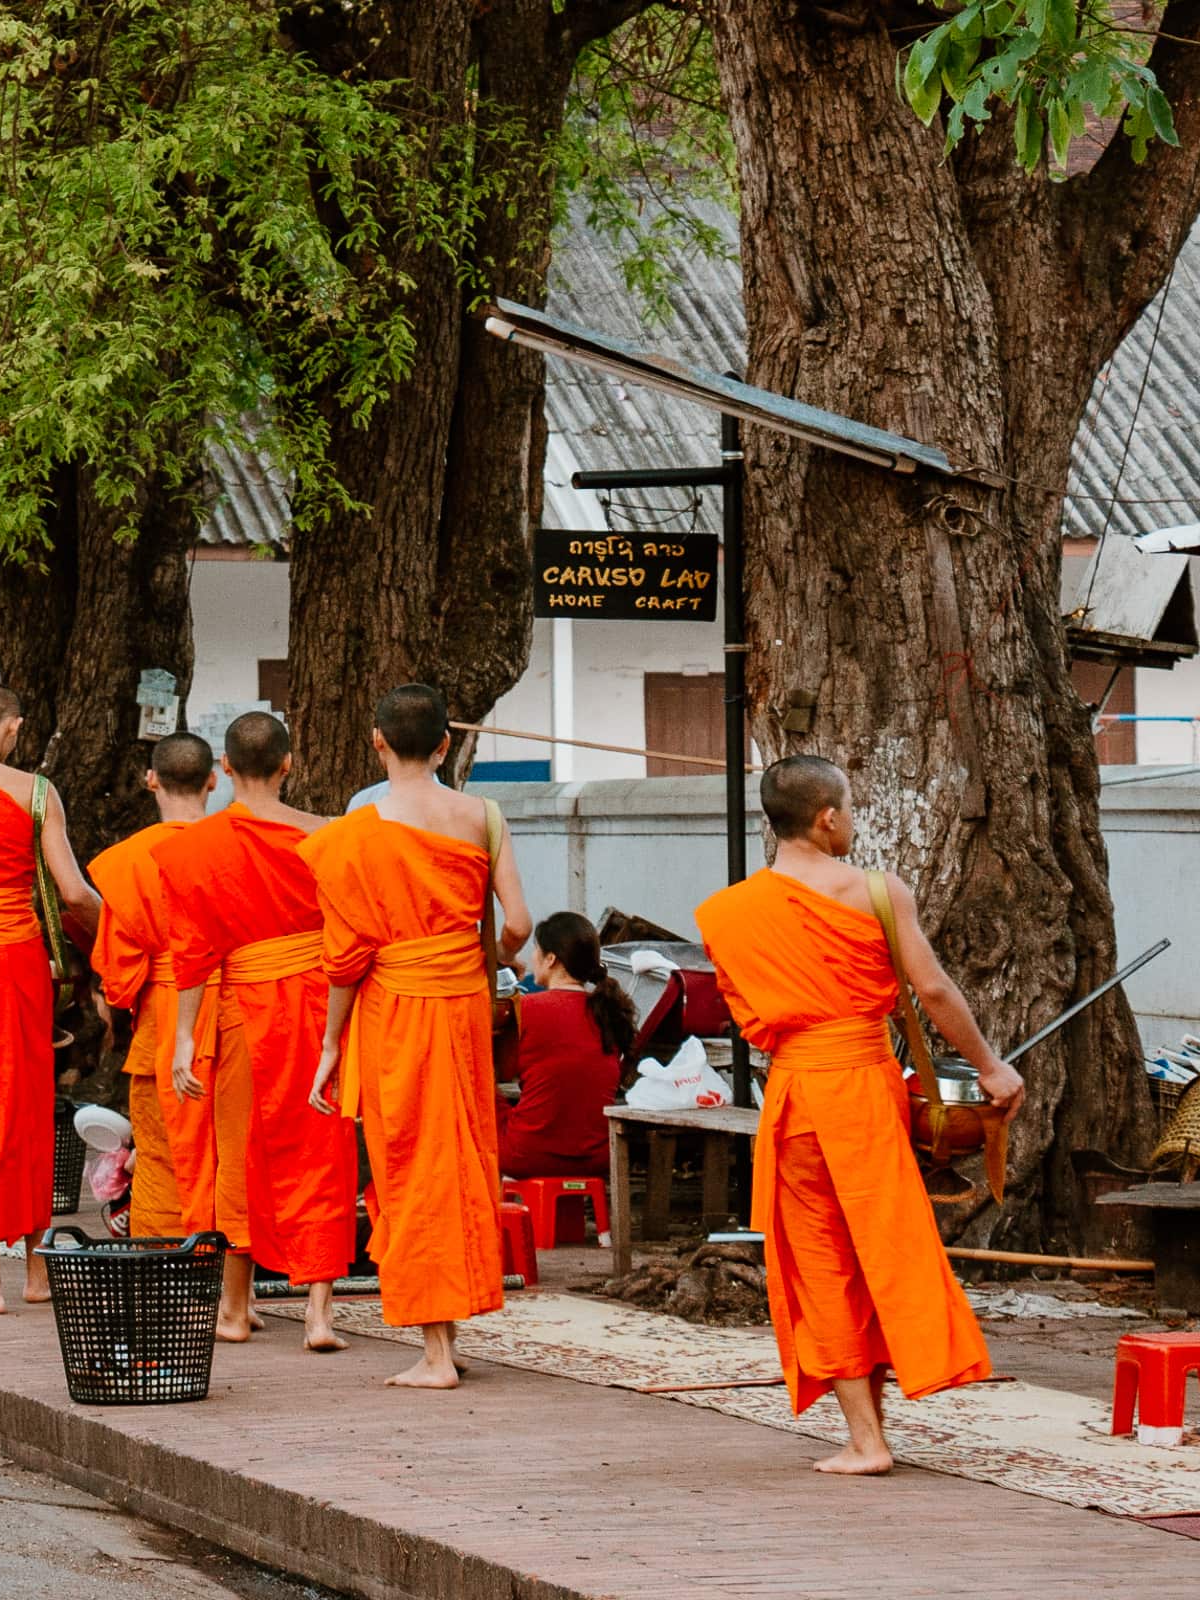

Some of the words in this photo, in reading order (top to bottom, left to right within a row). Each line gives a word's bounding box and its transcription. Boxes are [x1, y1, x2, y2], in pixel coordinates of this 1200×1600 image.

[543, 566, 646, 587] CARUSO
[660, 568, 711, 589] LAO
[549, 594, 605, 608] HOME
[635, 596, 702, 610] CRAFT
